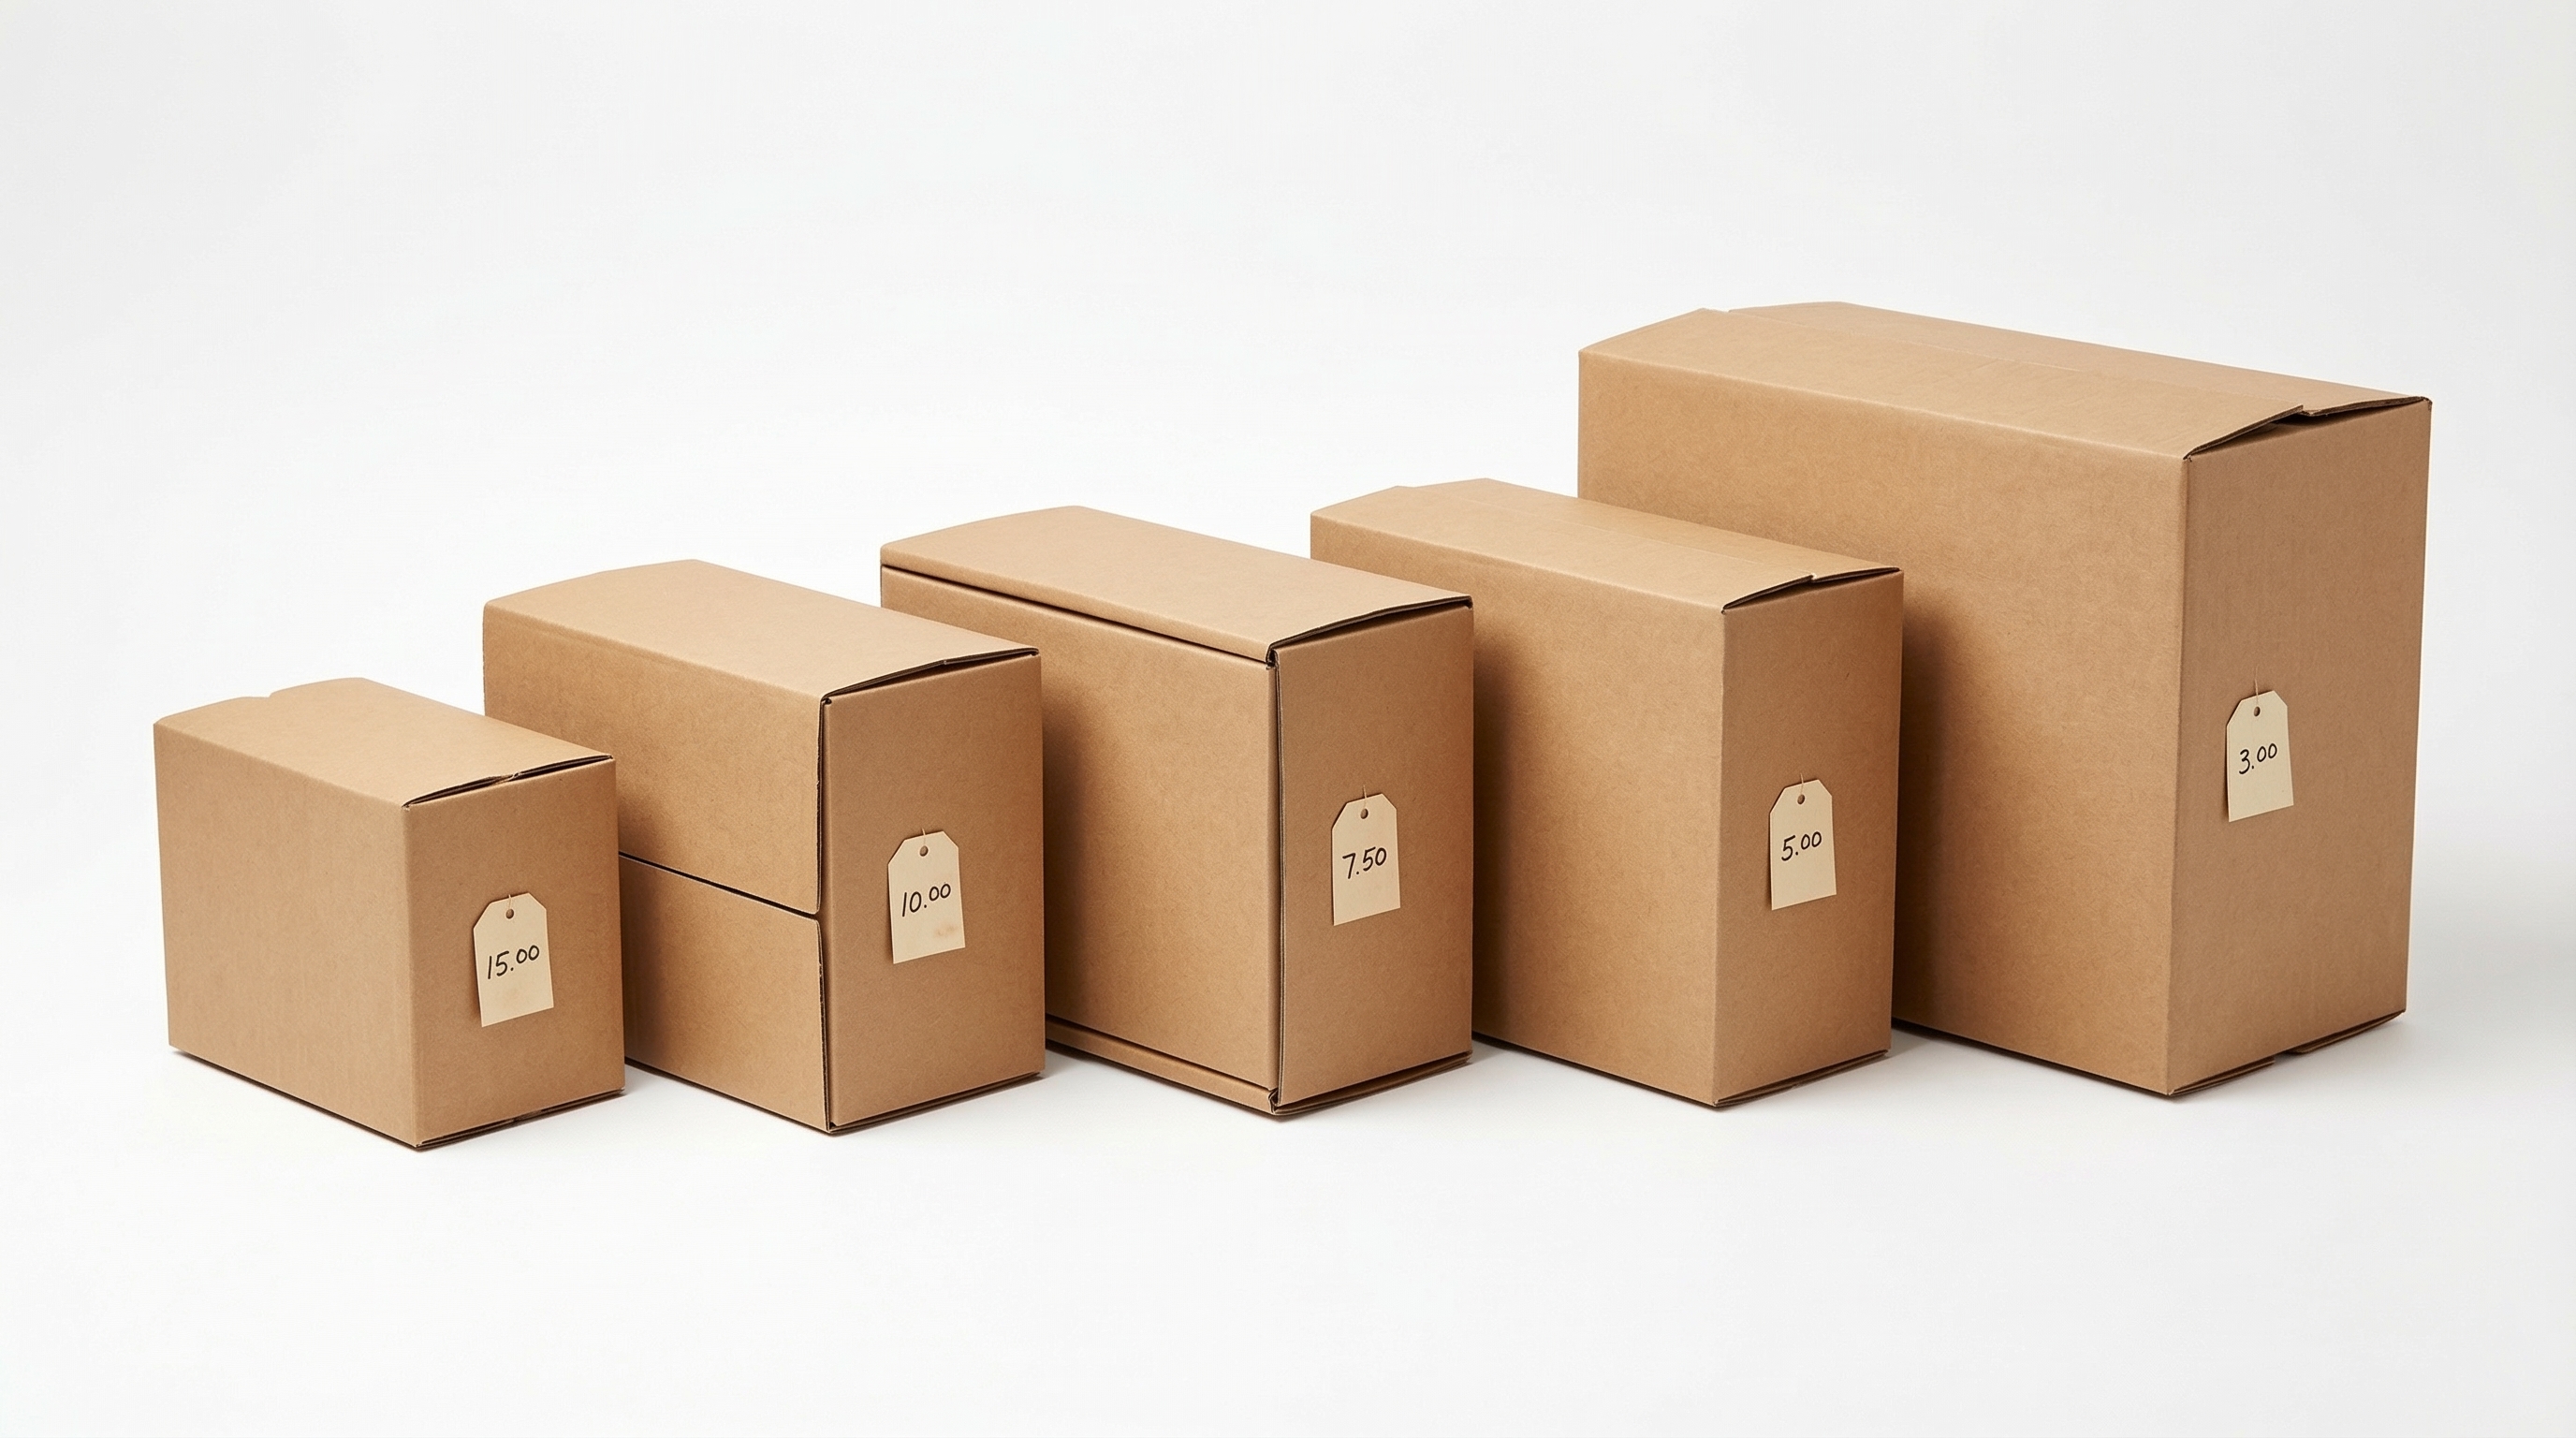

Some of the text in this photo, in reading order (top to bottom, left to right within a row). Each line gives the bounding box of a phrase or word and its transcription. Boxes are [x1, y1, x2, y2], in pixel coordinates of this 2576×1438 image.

[2238, 742, 2278, 775] 3.00
[1341, 845, 1387, 880] 7.50
[1780, 830, 1822, 862] 5.00
[900, 883, 952, 917] 10.00
[487, 945, 540, 980] 15.00
